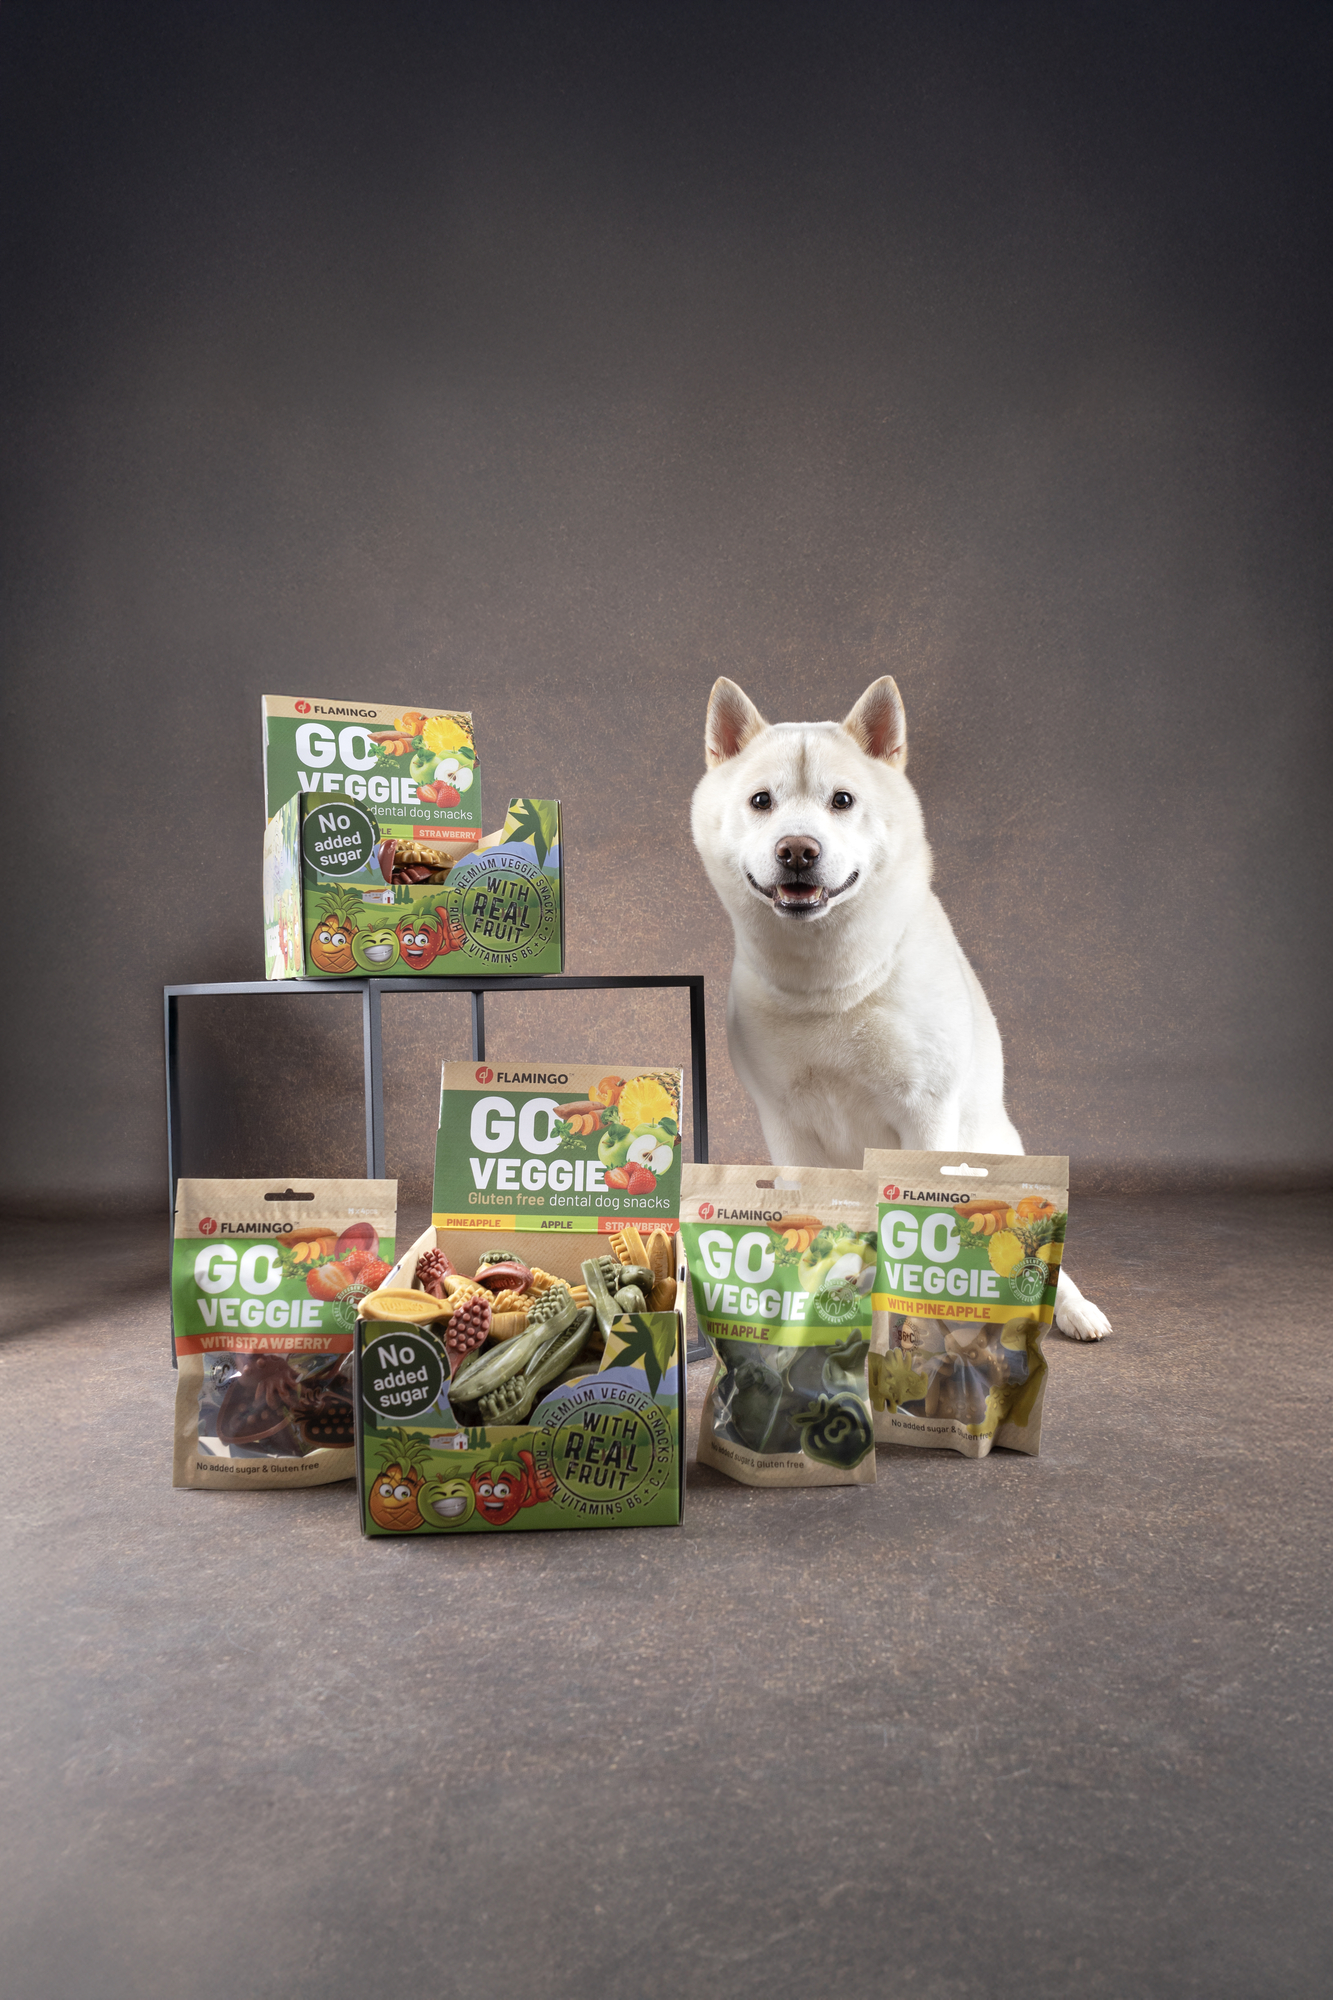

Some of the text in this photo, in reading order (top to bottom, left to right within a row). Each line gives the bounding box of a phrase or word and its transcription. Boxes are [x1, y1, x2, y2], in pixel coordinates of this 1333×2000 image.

[314, 706, 377, 718] FLAMINGO
[295, 722, 378, 772] GO
[297, 771, 421, 805] VEGGIE
[318, 812, 350, 834] No
[370, 805, 473, 820] dental dog snacks
[314, 831, 362, 852] added
[419, 829, 476, 840] STRAWBERRY
[320, 848, 362, 866] sugar
[454, 858, 554, 922] PREMIUM VEGGIE SNACKS
[487, 876, 530, 902] WITH
[472, 892, 530, 929] REAL
[449, 907, 462, 932] RICH
[457, 934, 470, 946] IN
[469, 944, 518, 964] VITAMINS
[520, 946, 534, 958] B6
[472, 917, 524, 944] FRUIT
[496, 1072, 568, 1085] FLAMINGO
[470, 1096, 564, 1155] GO
[469, 1157, 608, 1192] VEGGIE
[468, 1192, 670, 1210] Gluten free dental dog snacks
[903, 1190, 970, 1204] FLAMINGO
[220, 1222, 293, 1234] FLAMINGO
[446, 1218, 502, 1228] PINEAPPLE
[540, 1220, 573, 1230] APPLE
[605, 1221, 673, 1232] STRAWBERRY
[717, 1208, 782, 1222] FLAMINGO
[880, 1210, 961, 1264] GO
[194, 1244, 283, 1296] GO
[698, 1230, 776, 1284] GO
[884, 1261, 1000, 1298] VEGGIE
[196, 1298, 324, 1328] VEGGIE
[702, 1282, 810, 1321] VEGGIE
[887, 1298, 990, 1319] WITH PINEAPPLE
[200, 1336, 332, 1350] WITH STRAWBERRY
[706, 1320, 770, 1340] WITH APPLE
[377, 1344, 416, 1370] No
[373, 1365, 428, 1391] added
[380, 1386, 429, 1408] sugar
[541, 1387, 670, 1464] PREMIUM VEGGIE SNACKS
[583, 1411, 638, 1440] WITH
[892, 1418, 902, 1428] No
[903, 1422, 926, 1432] added
[927, 1426, 949, 1434] sugar
[957, 1428, 978, 1440] Gluten
[980, 1431, 992, 1440] free
[564, 1431, 638, 1472] REAL
[718, 1446, 734, 1459] added
[734, 1453, 750, 1466] sugar
[756, 1460, 784, 1468] Gluten
[786, 1460, 804, 1468] free
[196, 1462, 320, 1474] No added sugar & Gluten free
[566, 1461, 630, 1491] FRUIT
[536, 1450, 552, 1480] RICH
[546, 1482, 562, 1496] IN
[560, 1492, 623, 1516] VITAMINS
[626, 1494, 642, 1509] B6
